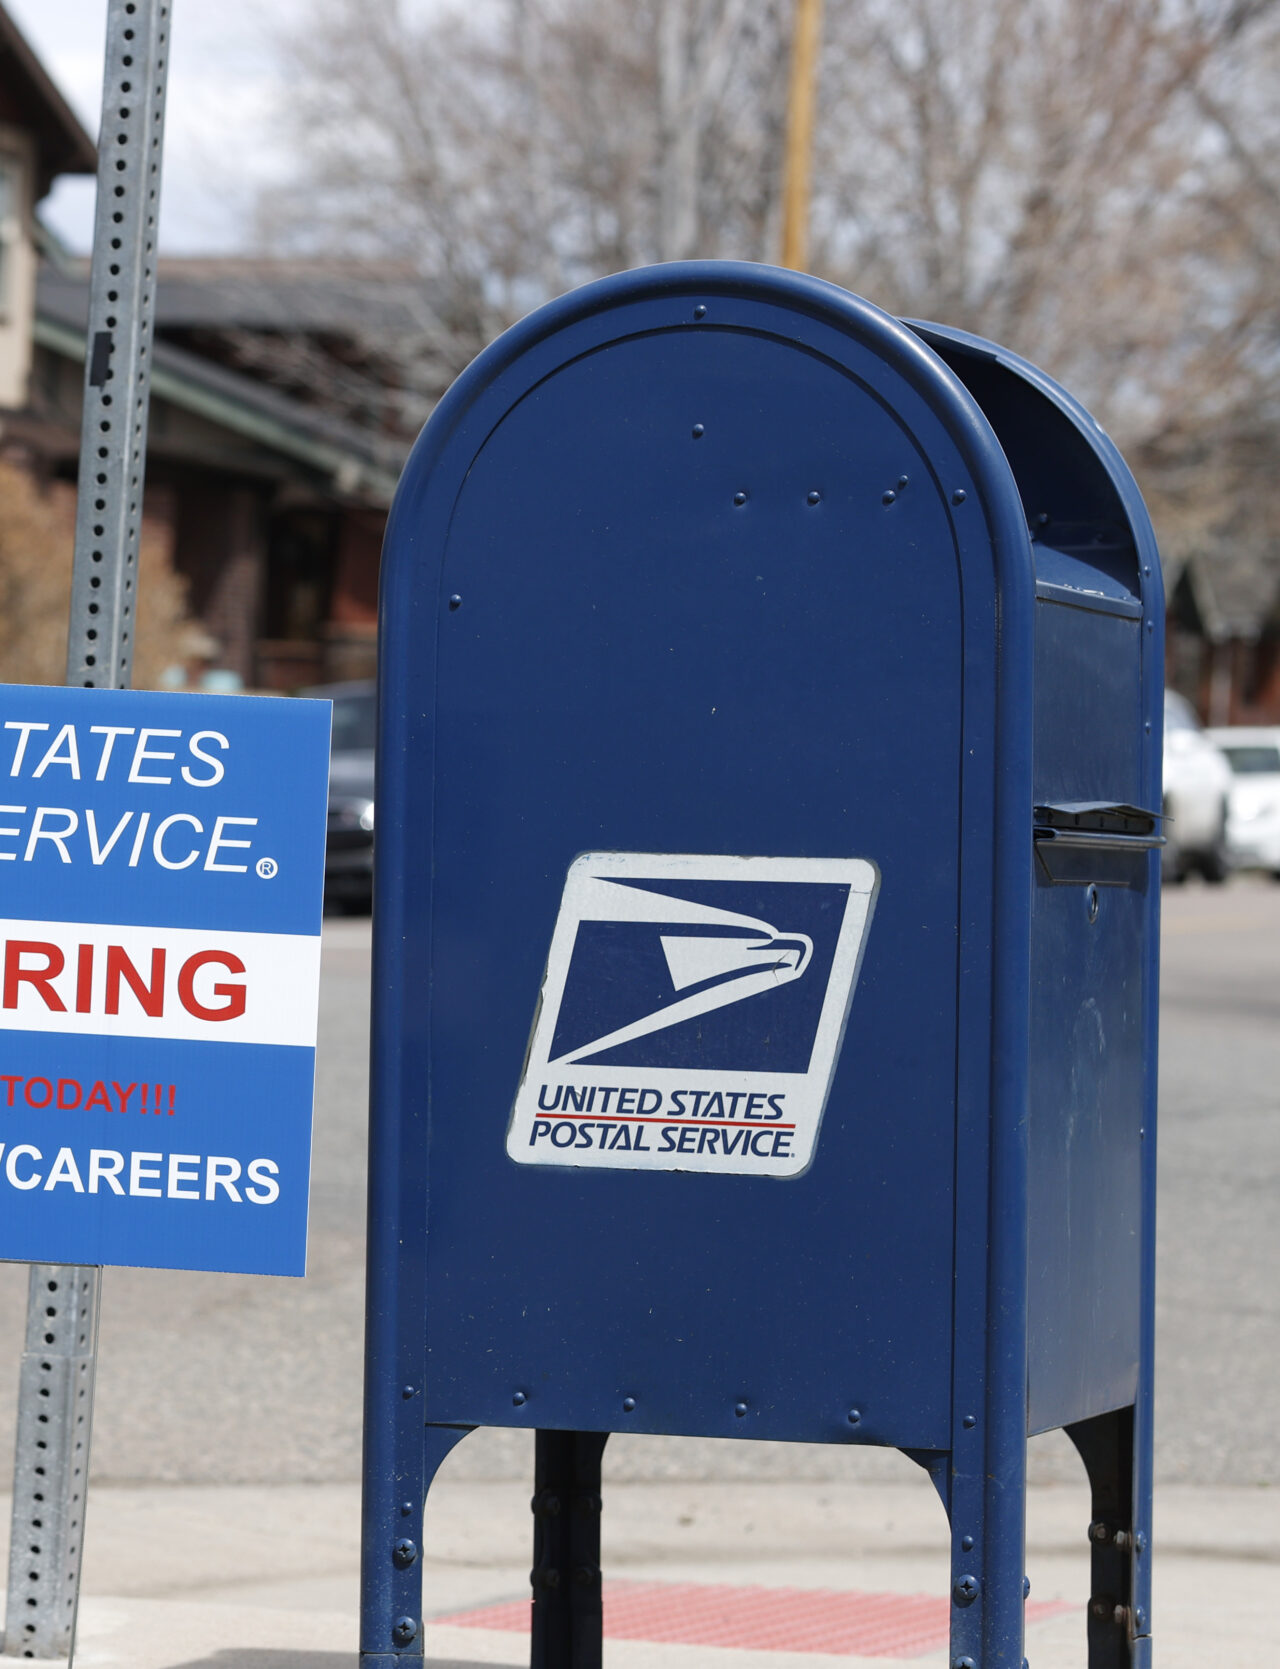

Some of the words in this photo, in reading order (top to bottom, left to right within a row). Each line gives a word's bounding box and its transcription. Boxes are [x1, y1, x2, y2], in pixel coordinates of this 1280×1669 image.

[0, 1074, 176, 1116] TODAY!!!
[537, 1084, 663, 1115] UNITED
[666, 1089, 786, 1121] STATES
[528, 1120, 651, 1152] POSTAL
